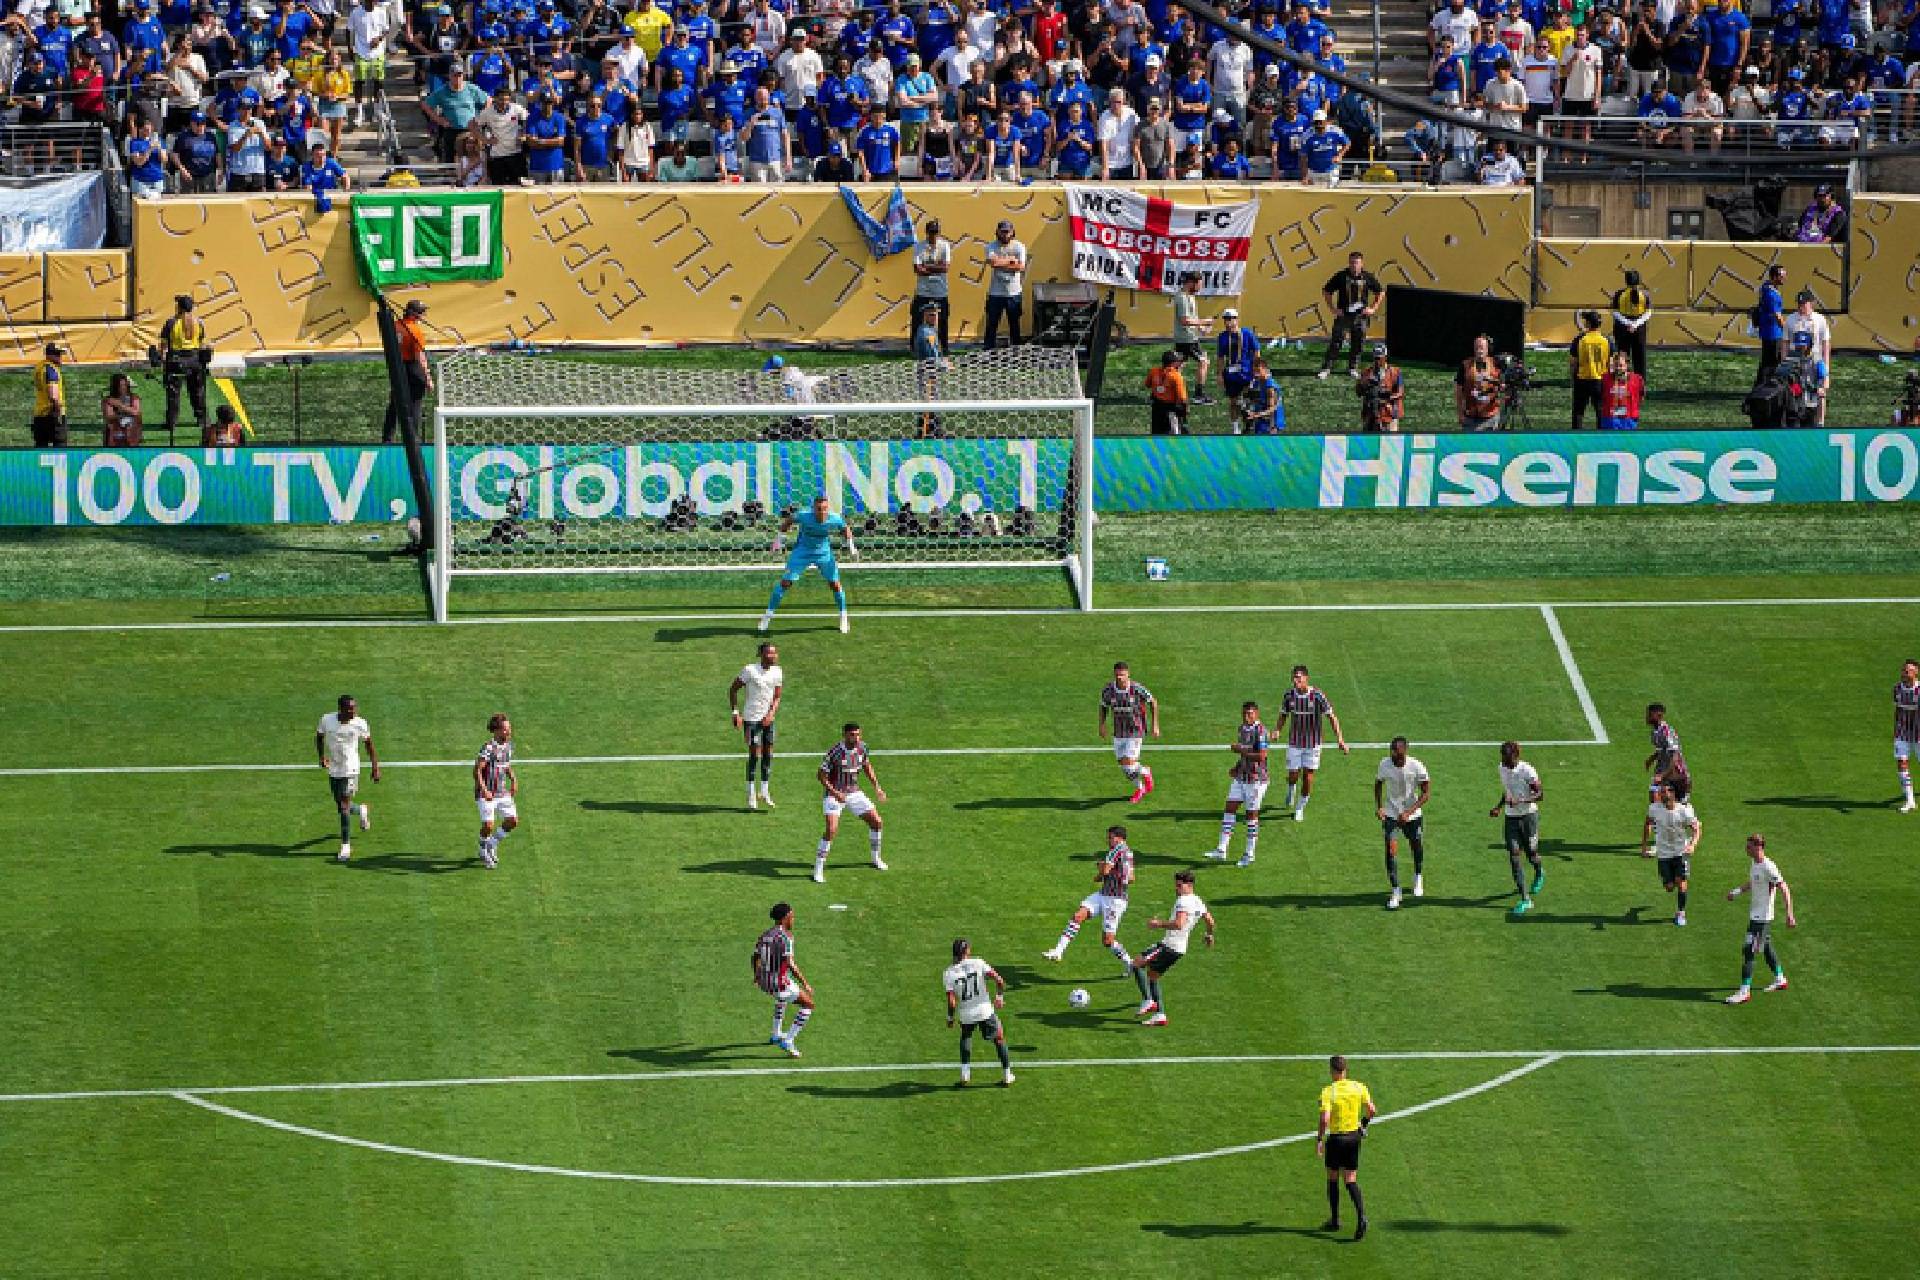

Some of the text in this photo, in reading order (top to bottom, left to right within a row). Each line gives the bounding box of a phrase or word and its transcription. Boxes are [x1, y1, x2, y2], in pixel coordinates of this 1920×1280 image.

[1083, 193, 1232, 229] MC FC
[1084, 222, 1231, 257] DOBCROSS
[1074, 253, 1125, 277] PRIDE
[39, 440, 1038, 525] 100" TV, Global No. 1
[1319, 435, 1777, 507] Hisense
